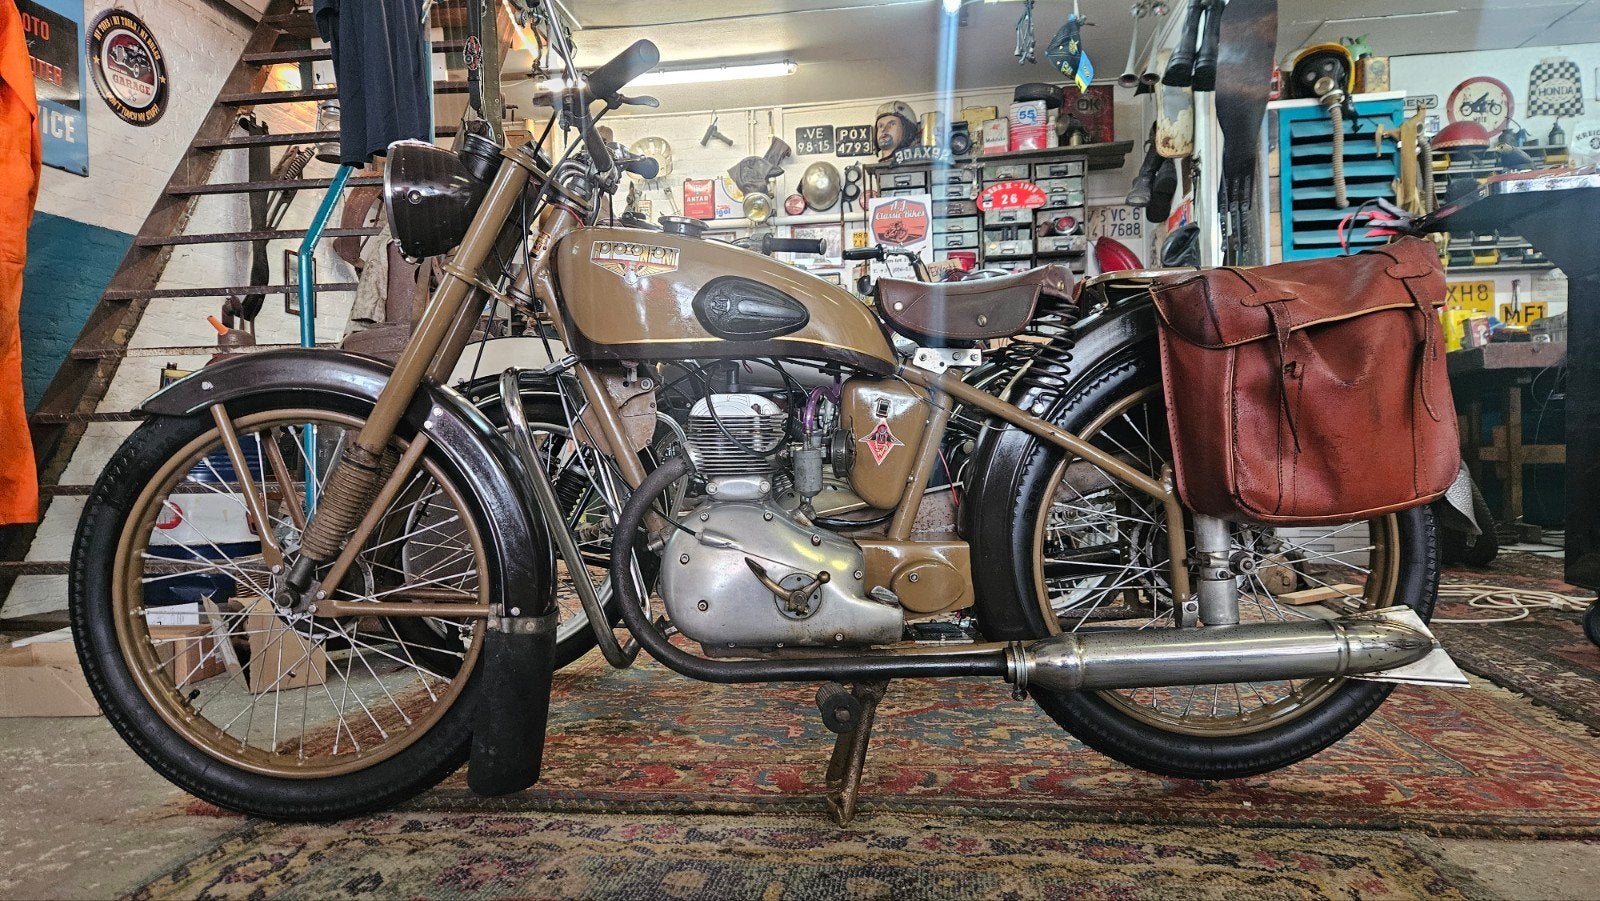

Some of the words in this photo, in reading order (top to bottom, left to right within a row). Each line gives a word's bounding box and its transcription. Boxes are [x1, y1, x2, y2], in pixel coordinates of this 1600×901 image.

[22, 12, 49, 40] OTO
[121, 16, 137, 31] TOOLS
[112, 74, 151, 96] GARAGE
[1538, 86, 1574, 96] HONDA
[1403, 97, 1434, 107] ENZ
[38, 105, 75, 143] ICE
[805, 127, 824, 140] VE
[840, 128, 867, 141] POX
[838, 142, 870, 154] 4793
[1001, 193, 1019, 205] 26
[716, 208, 731, 217] igol
[875, 211, 901, 220] Classic
[904, 209, 925, 218] Bikes
[1110, 208, 1126, 221] VC
[1132, 207, 1140, 220] 6
[1110, 222, 1141, 237] 7688
